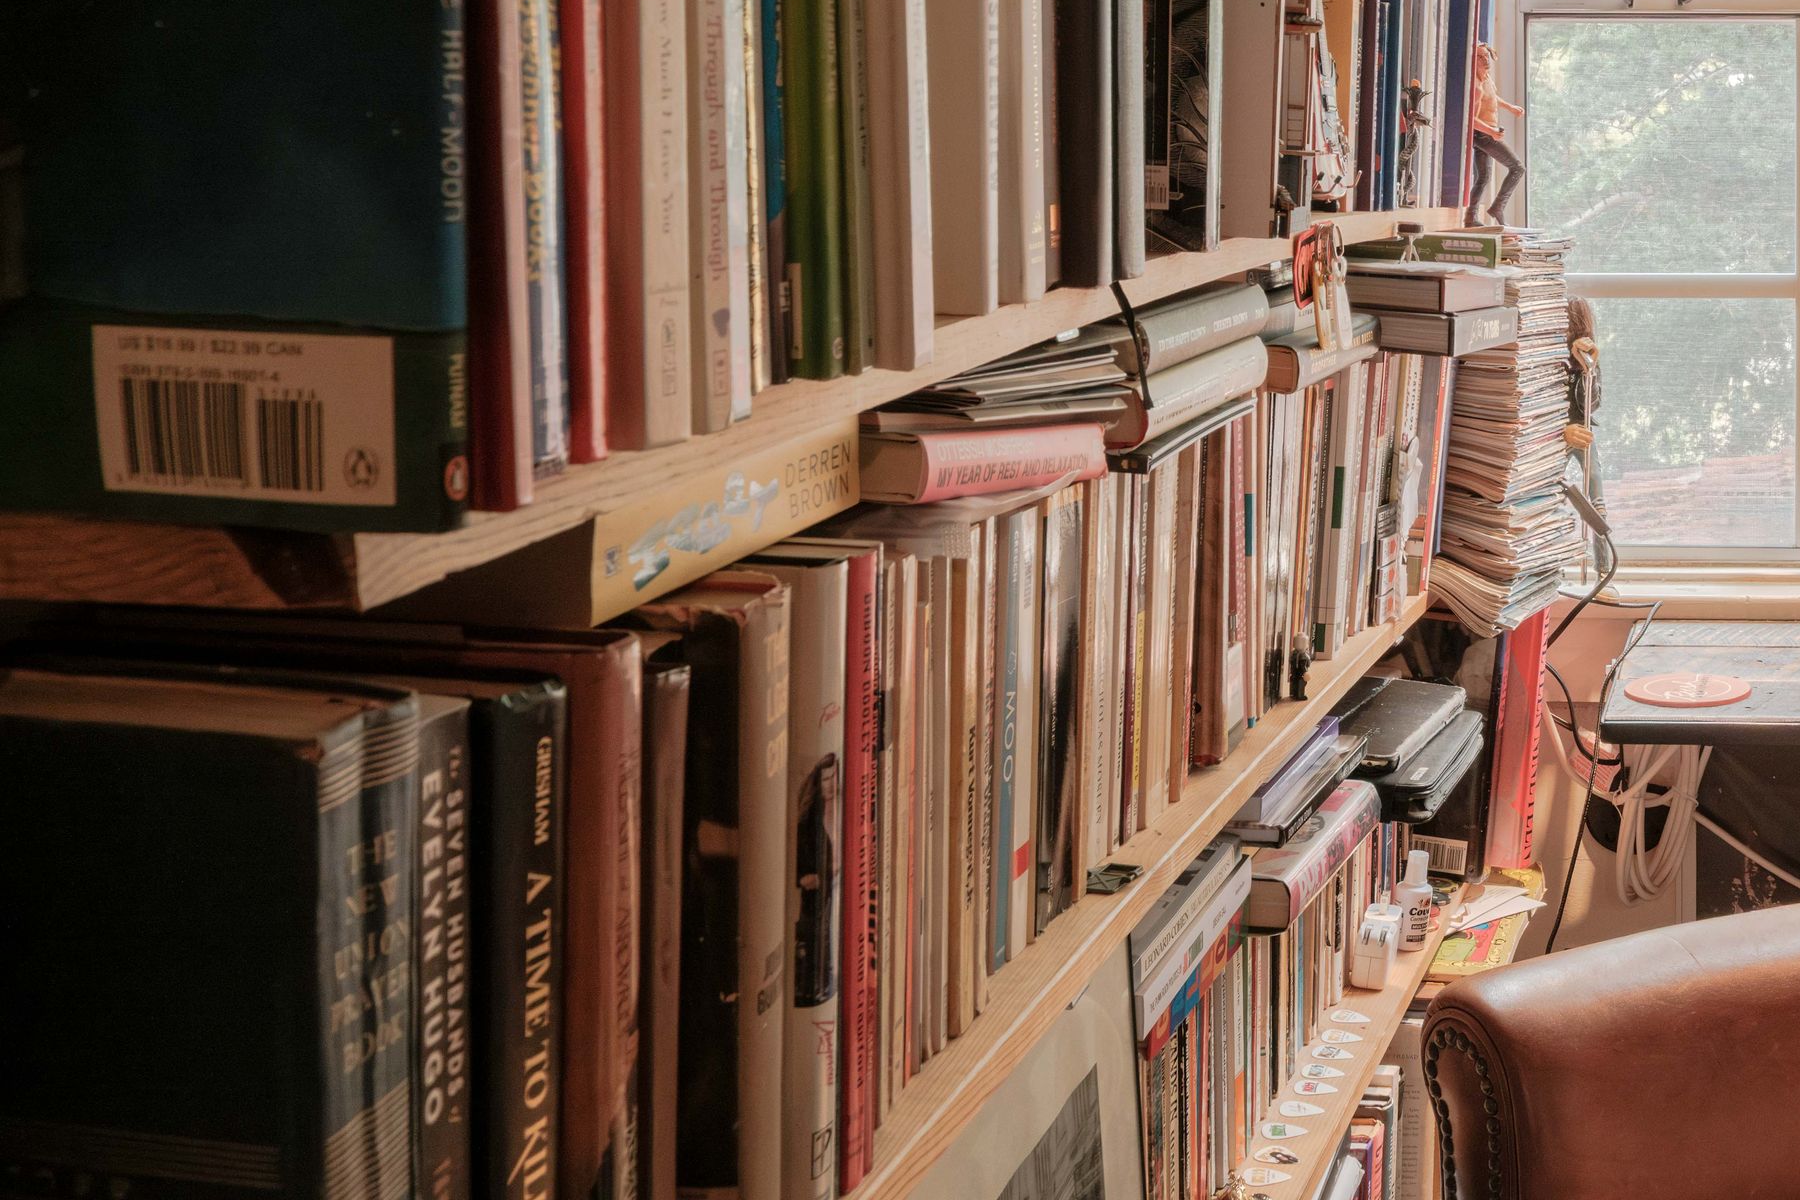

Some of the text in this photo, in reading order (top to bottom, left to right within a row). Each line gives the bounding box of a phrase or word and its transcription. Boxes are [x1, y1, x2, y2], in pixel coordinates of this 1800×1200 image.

[704, 16, 722, 120] Through
[708, 130, 724, 171] and
[708, 180, 726, 282] Through
[784, 444, 850, 488] DERREN
[790, 472, 850, 520] BROWN
[936, 452, 1088, 488] MY YEAR OF REST AND RELAXATION
[422, 768, 444, 1124] EVELYN HUGO
[523, 736, 553, 1108] GRISHAM A TIME TO
